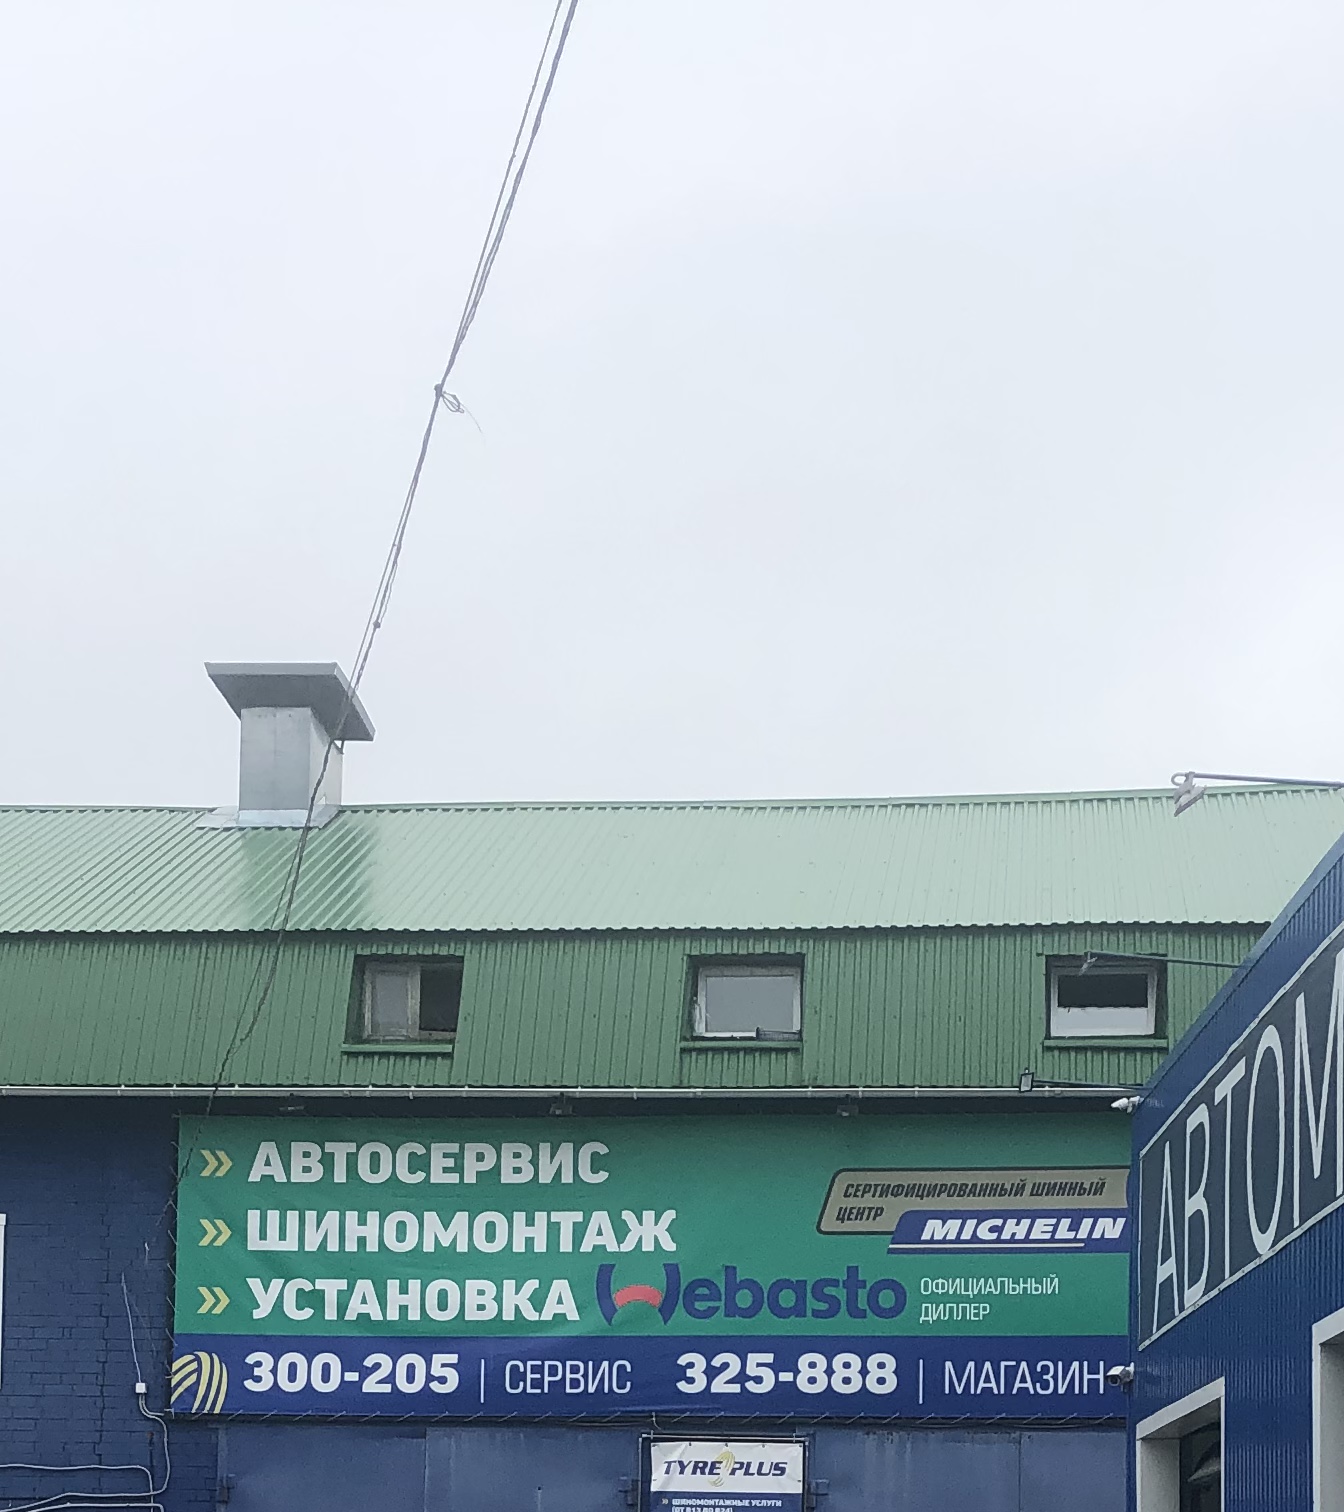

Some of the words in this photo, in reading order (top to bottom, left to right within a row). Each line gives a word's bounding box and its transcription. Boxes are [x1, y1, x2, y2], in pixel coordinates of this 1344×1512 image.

[248, 1141, 609, 1183] АВТОСЕРВИС
[842, 1178, 1026, 1200] СЕРТИФИЦИРОВАННЫЙ
[1029, 1176, 1107, 1197] ШИННЫЙ
[836, 1206, 885, 1223] ЦЕНТР
[247, 1209, 677, 1253] ШИНОМОНТАЖ
[920, 1217, 1126, 1241] MICHELIN
[246, 1277, 580, 1321] УСТАНОВКА
[596, 1263, 907, 1325] Webasto
[920, 1274, 1059, 1297] ОФИЦИАЛЬНЫЙ
[920, 1303, 990, 1324] ДИЛЛЕР
[243, 1352, 459, 1394] 300-205
[505, 1359, 632, 1394] СЕРВИС
[676, 1352, 898, 1395] 325-888
[944, 1360, 1105, 1395] МАГАЗИН
[663, 1460, 723, 1476] TYRE
[729, 1461, 788, 1477] PLUS
[671, 1498, 750, 1507] ШИНОМОНТАЖНЫЕ
[751, 1499, 782, 1507] УСЛУГИ
